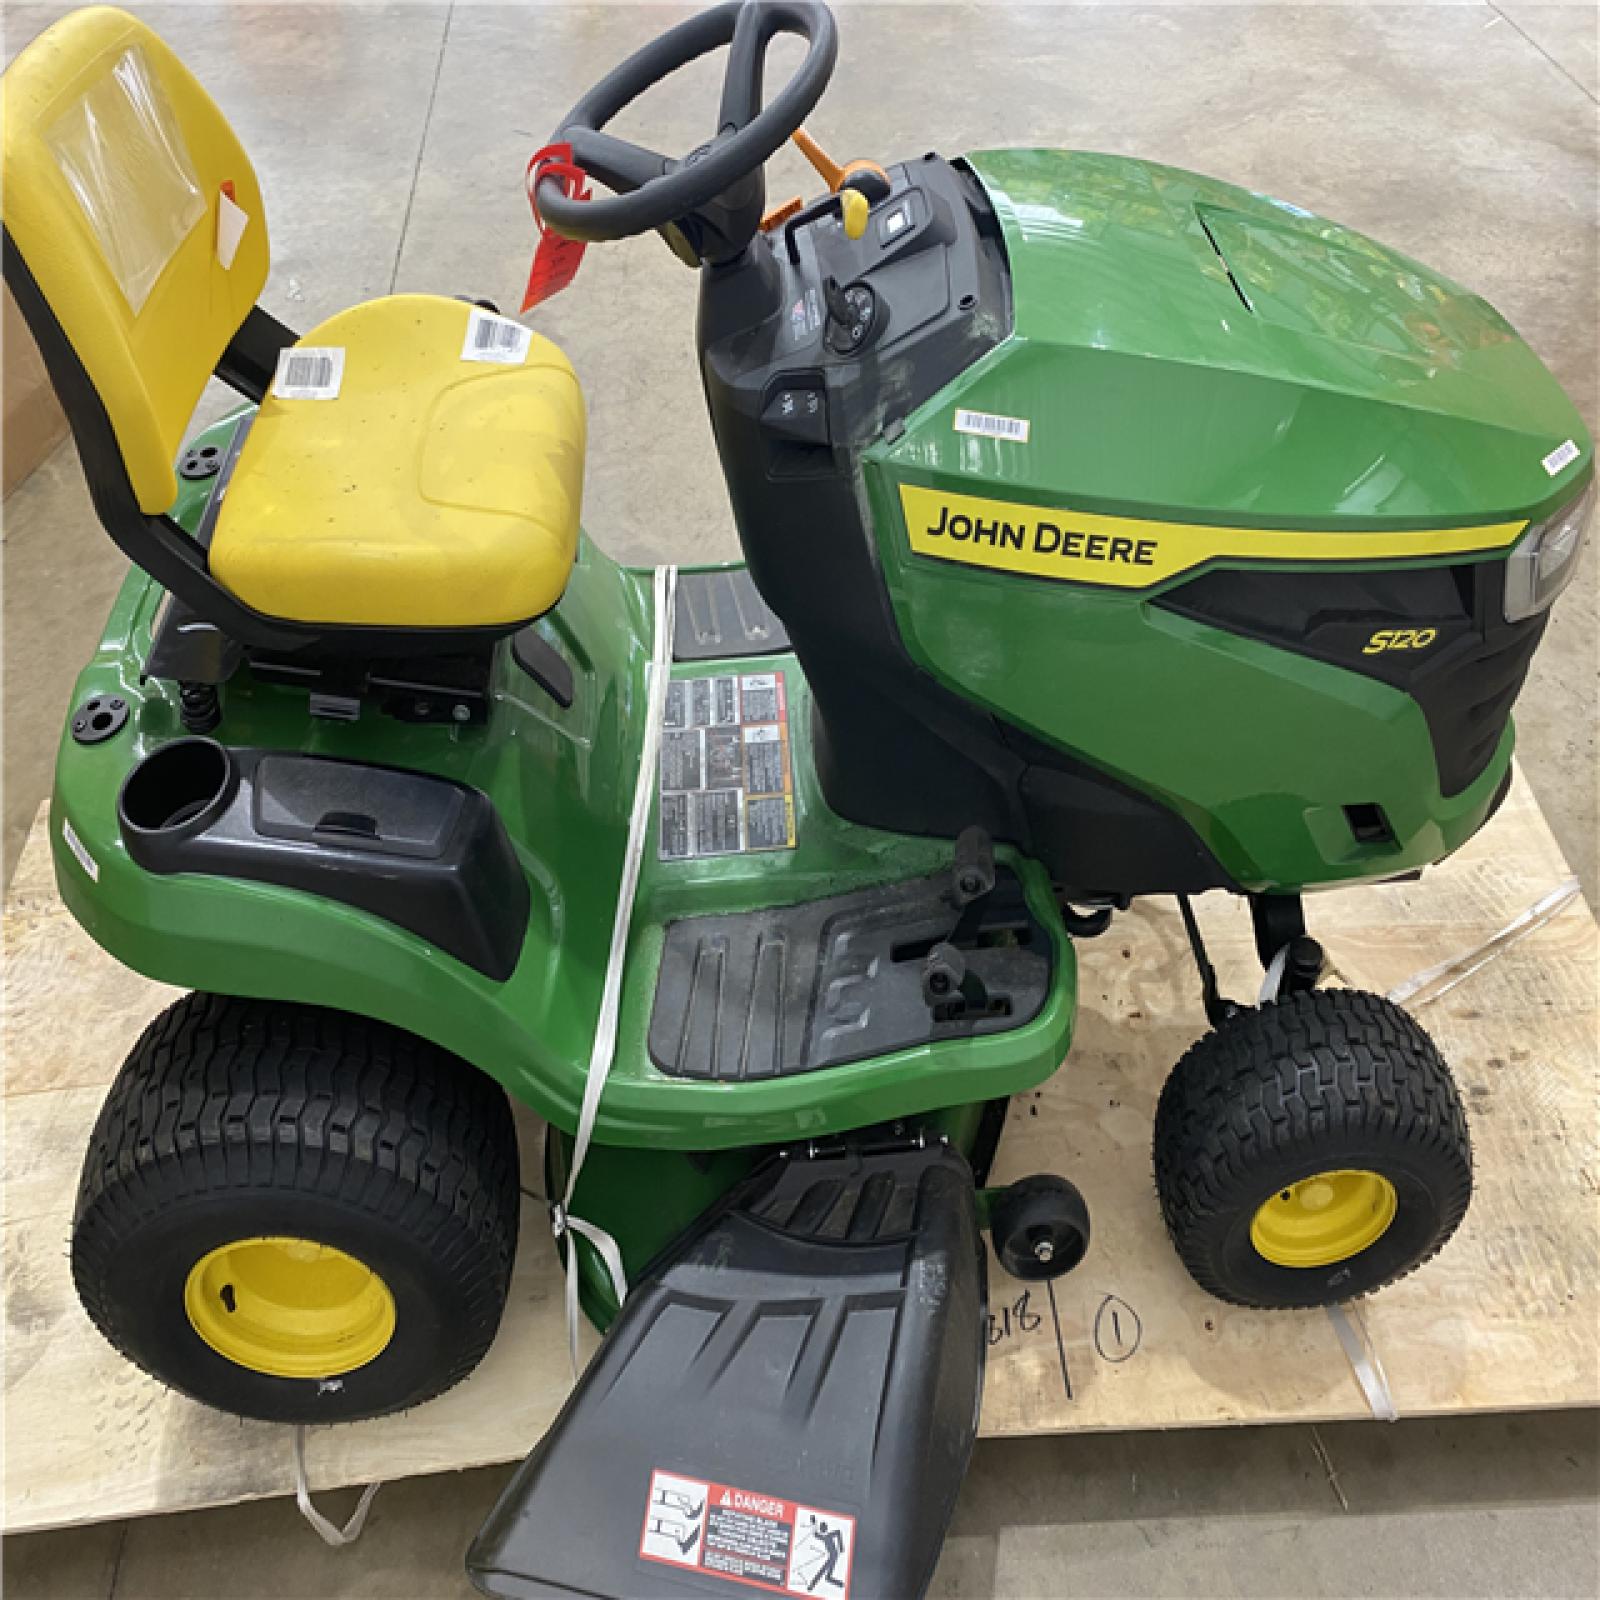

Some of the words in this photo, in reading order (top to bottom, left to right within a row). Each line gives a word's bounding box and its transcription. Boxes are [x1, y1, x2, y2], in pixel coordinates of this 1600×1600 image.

[927, 506, 1026, 550] JOHN
[1033, 522, 1158, 566] DEERE
[1362, 628, 1437, 654] S120
[734, 1492, 785, 1518] DANGER
